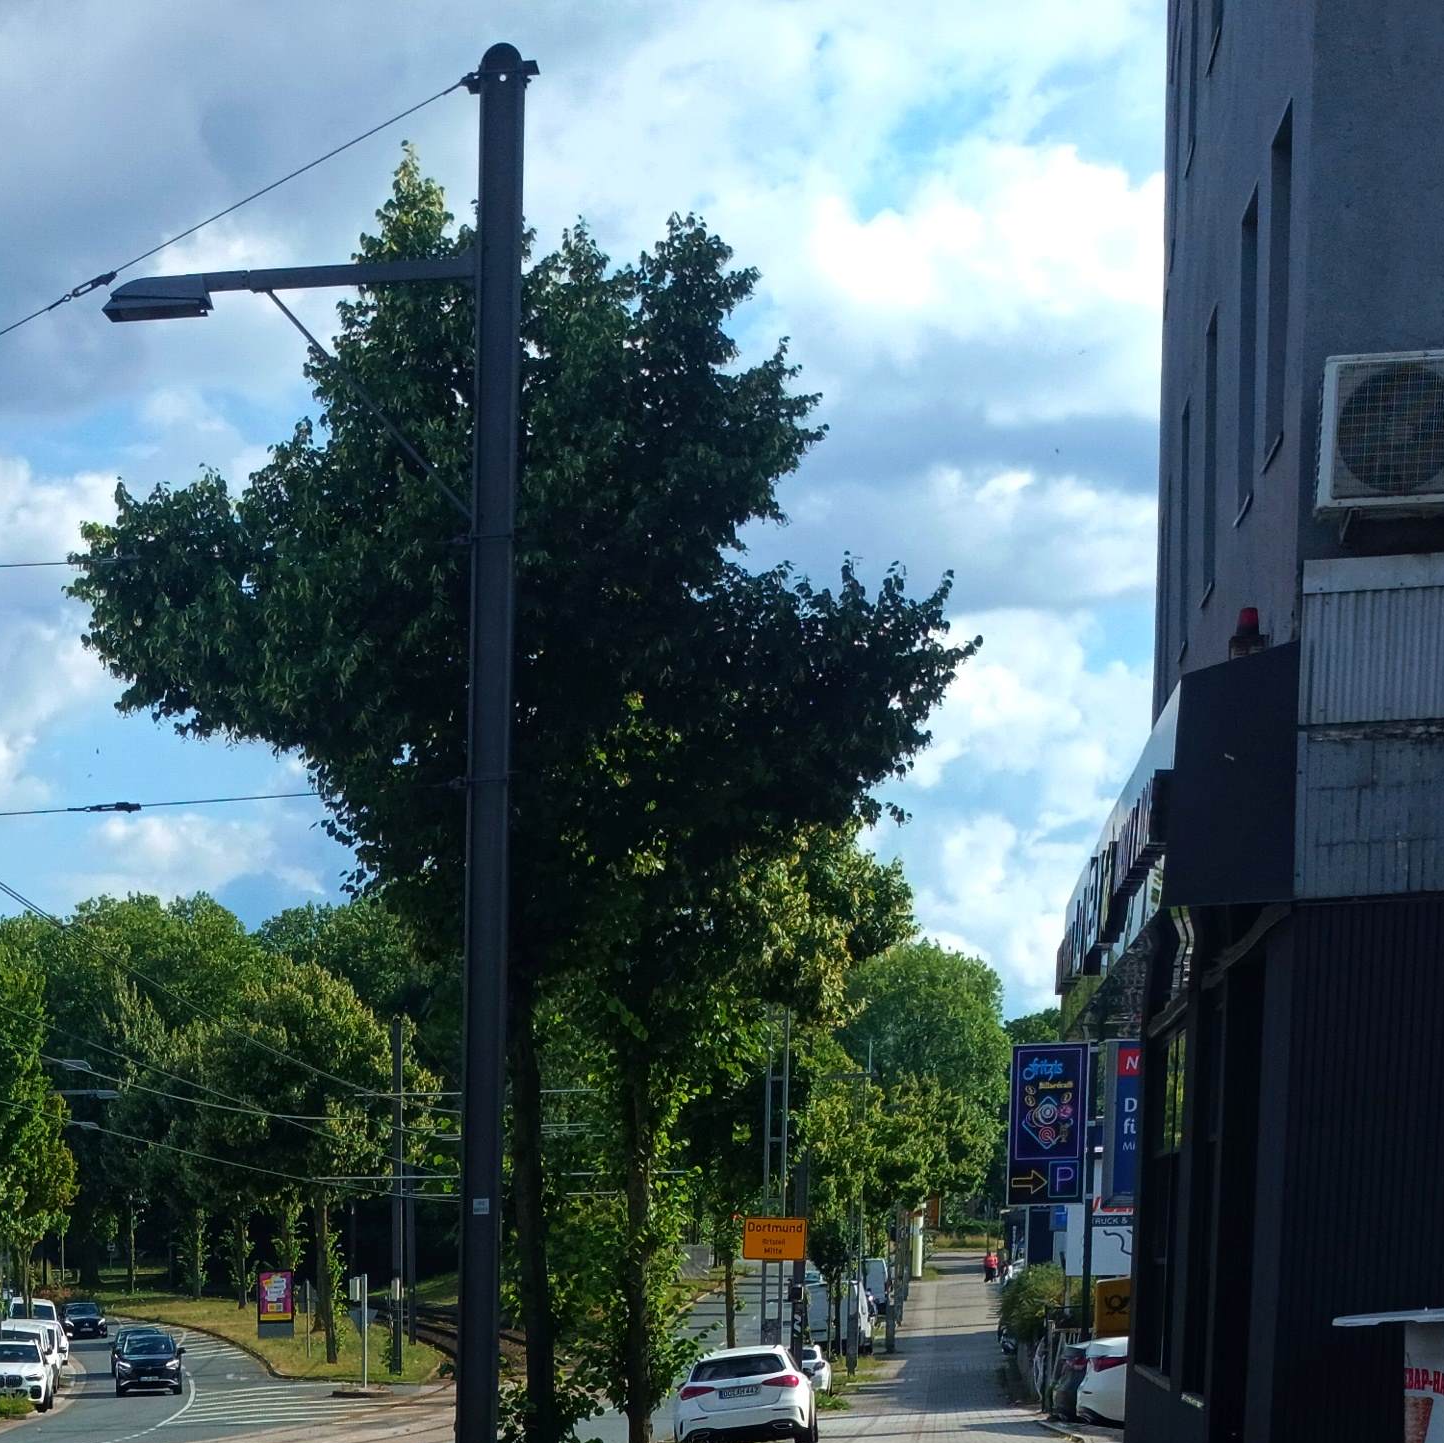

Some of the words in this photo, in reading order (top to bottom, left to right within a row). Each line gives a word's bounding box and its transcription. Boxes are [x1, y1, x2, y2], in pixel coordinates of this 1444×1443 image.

[1023, 1057, 1064, 1081] fritzis
[1057, 1166, 1074, 1192] P
[747, 1222, 803, 1233] Dortmund
